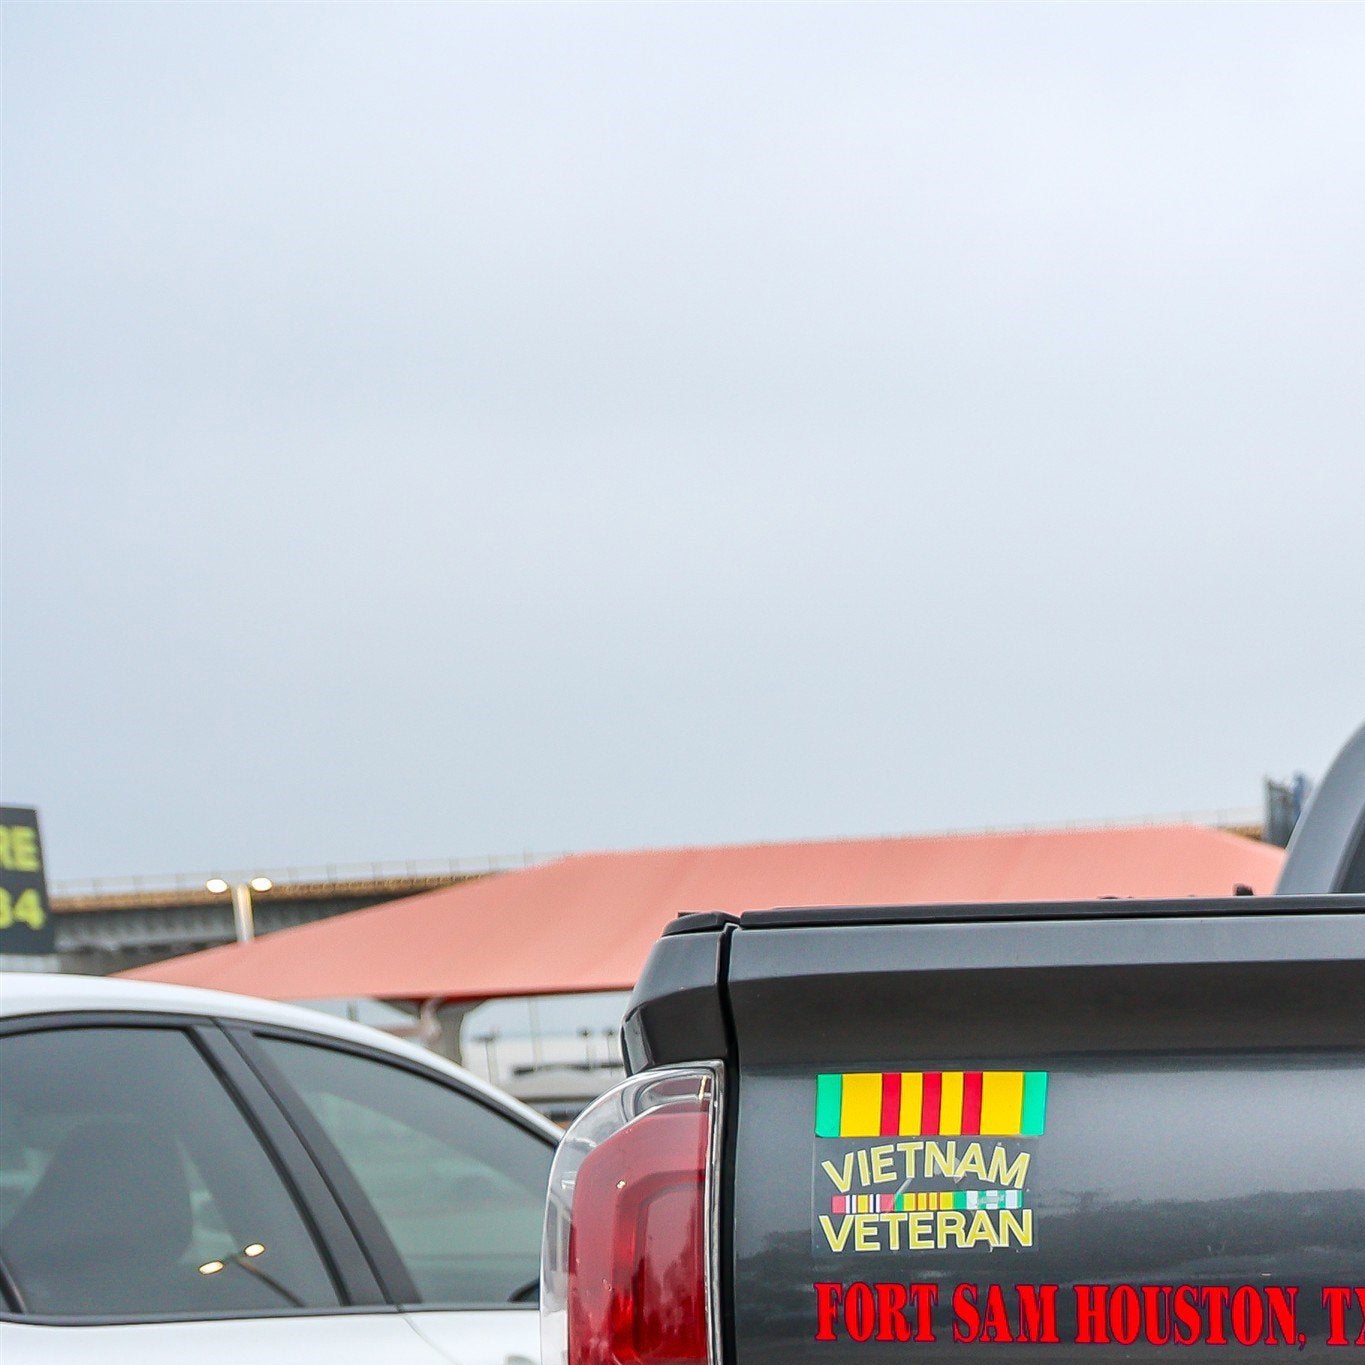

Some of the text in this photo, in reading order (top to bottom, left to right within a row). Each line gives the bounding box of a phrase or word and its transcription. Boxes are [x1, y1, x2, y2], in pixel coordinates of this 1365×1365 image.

[821, 1140, 1030, 1194] VIETNAM
[818, 1208, 1033, 1253] VETERAN
[813, 1282, 937, 1343] FORT
[952, 1283, 1059, 1343] SAM
[1074, 1284, 1306, 1349] HOUSTON,
